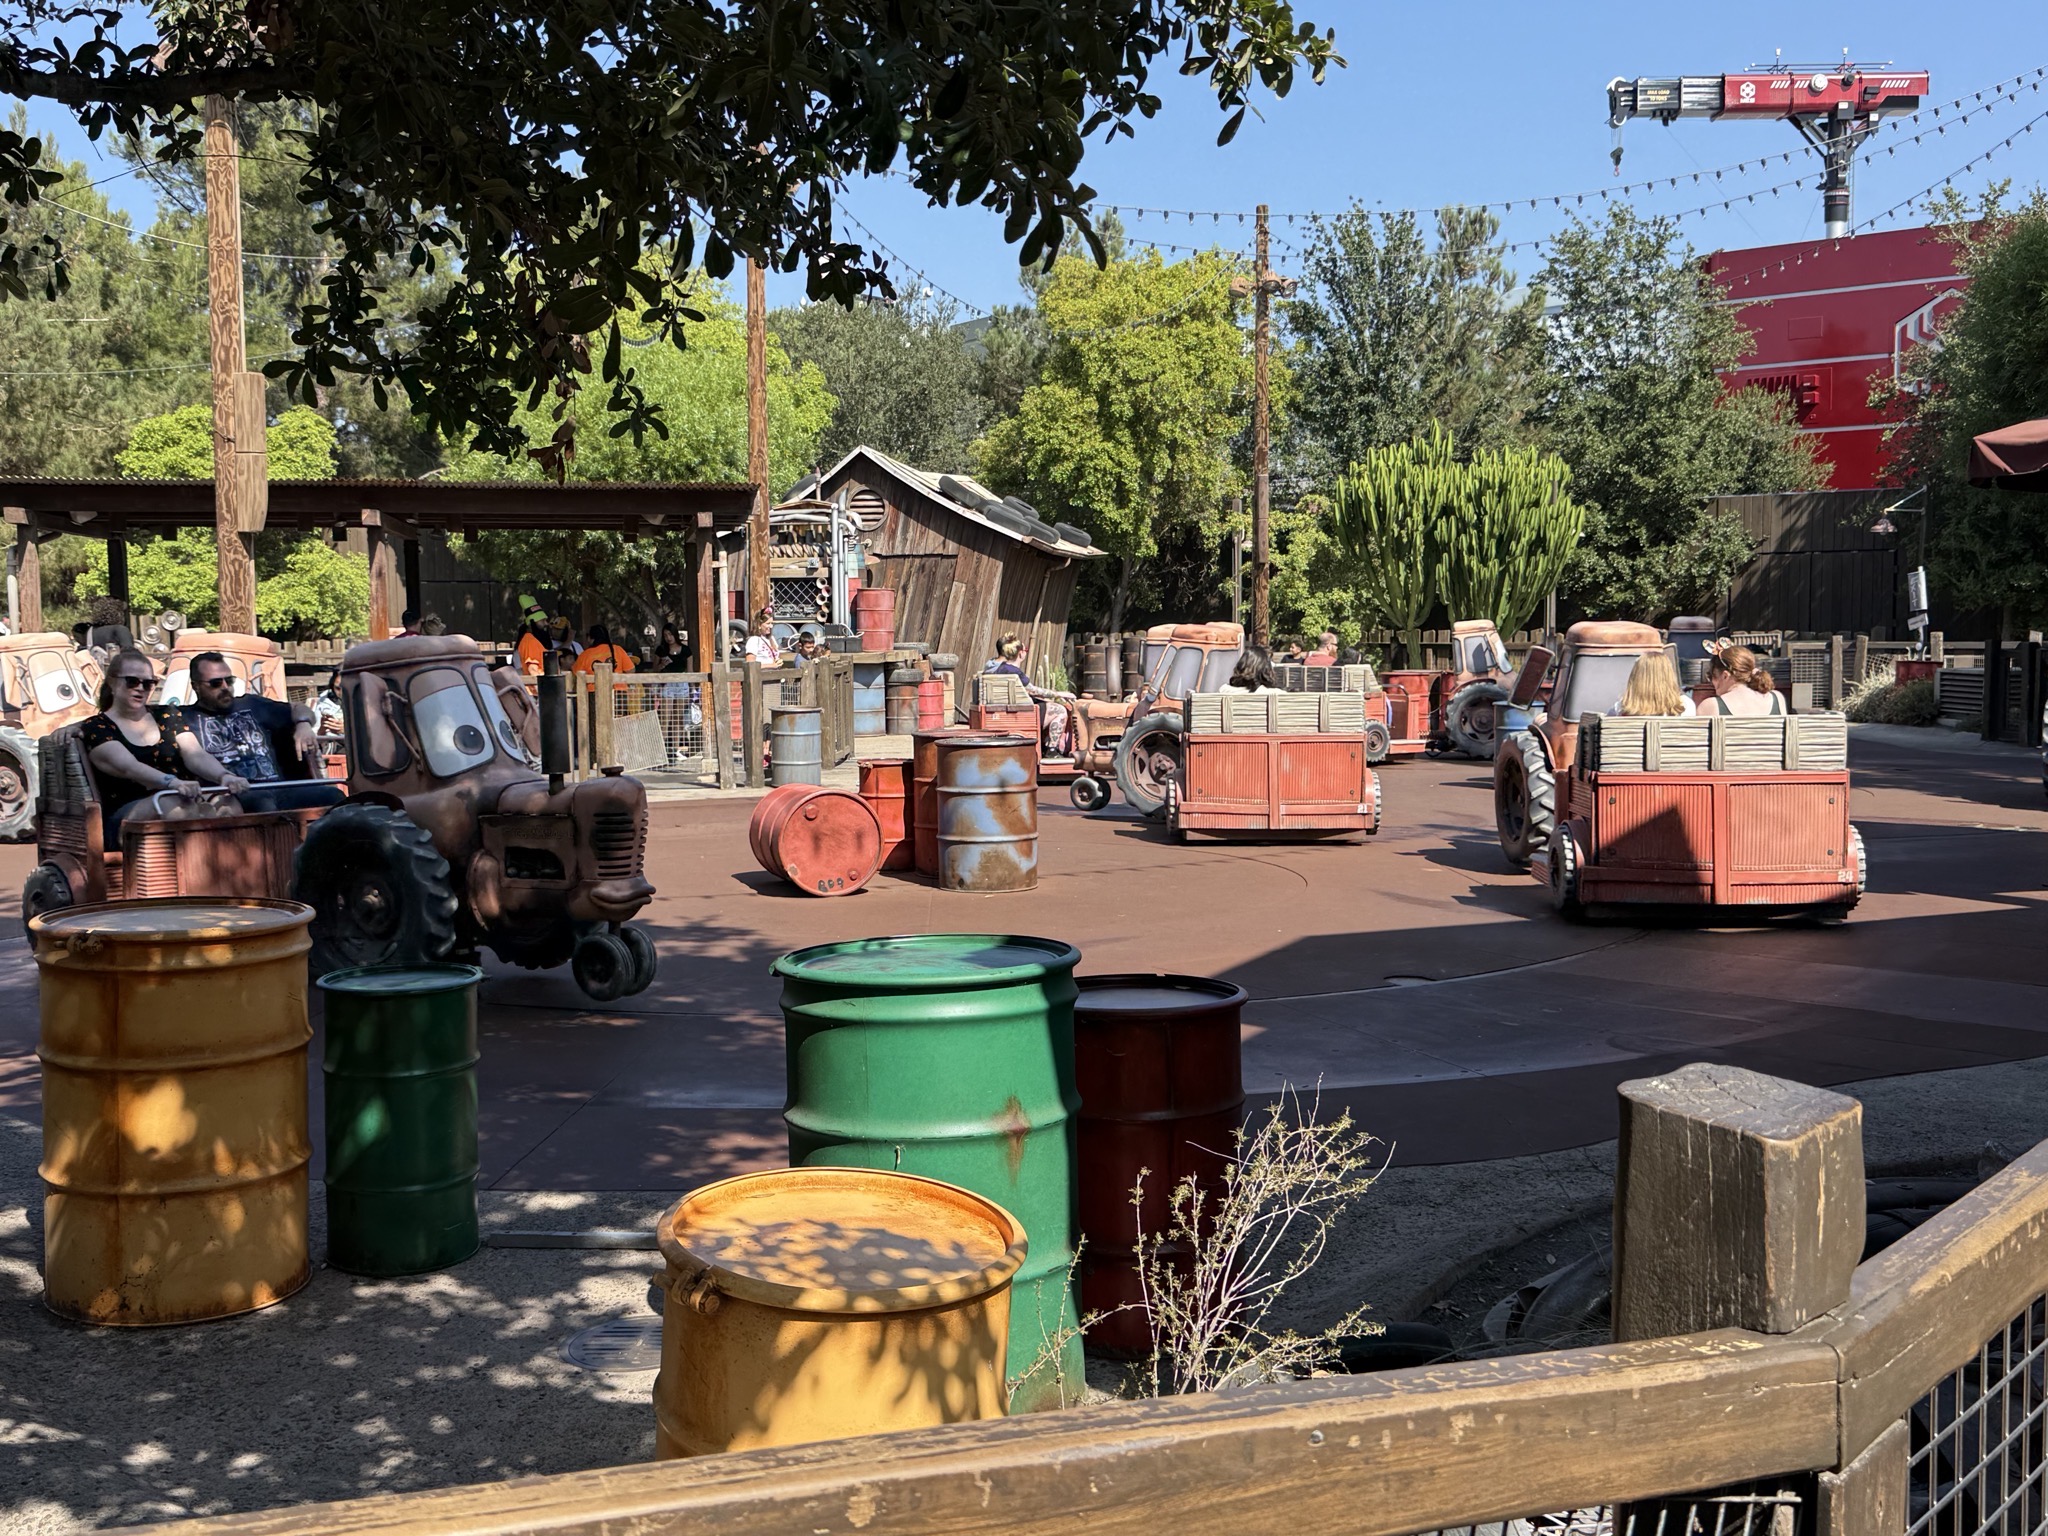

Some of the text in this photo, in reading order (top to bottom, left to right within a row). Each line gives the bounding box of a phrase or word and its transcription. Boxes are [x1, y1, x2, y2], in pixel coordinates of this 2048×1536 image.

[1910, 576, 1919, 607] EXIT
[1357, 804, 1368, 814] 21
[1837, 870, 1853, 882] 24
